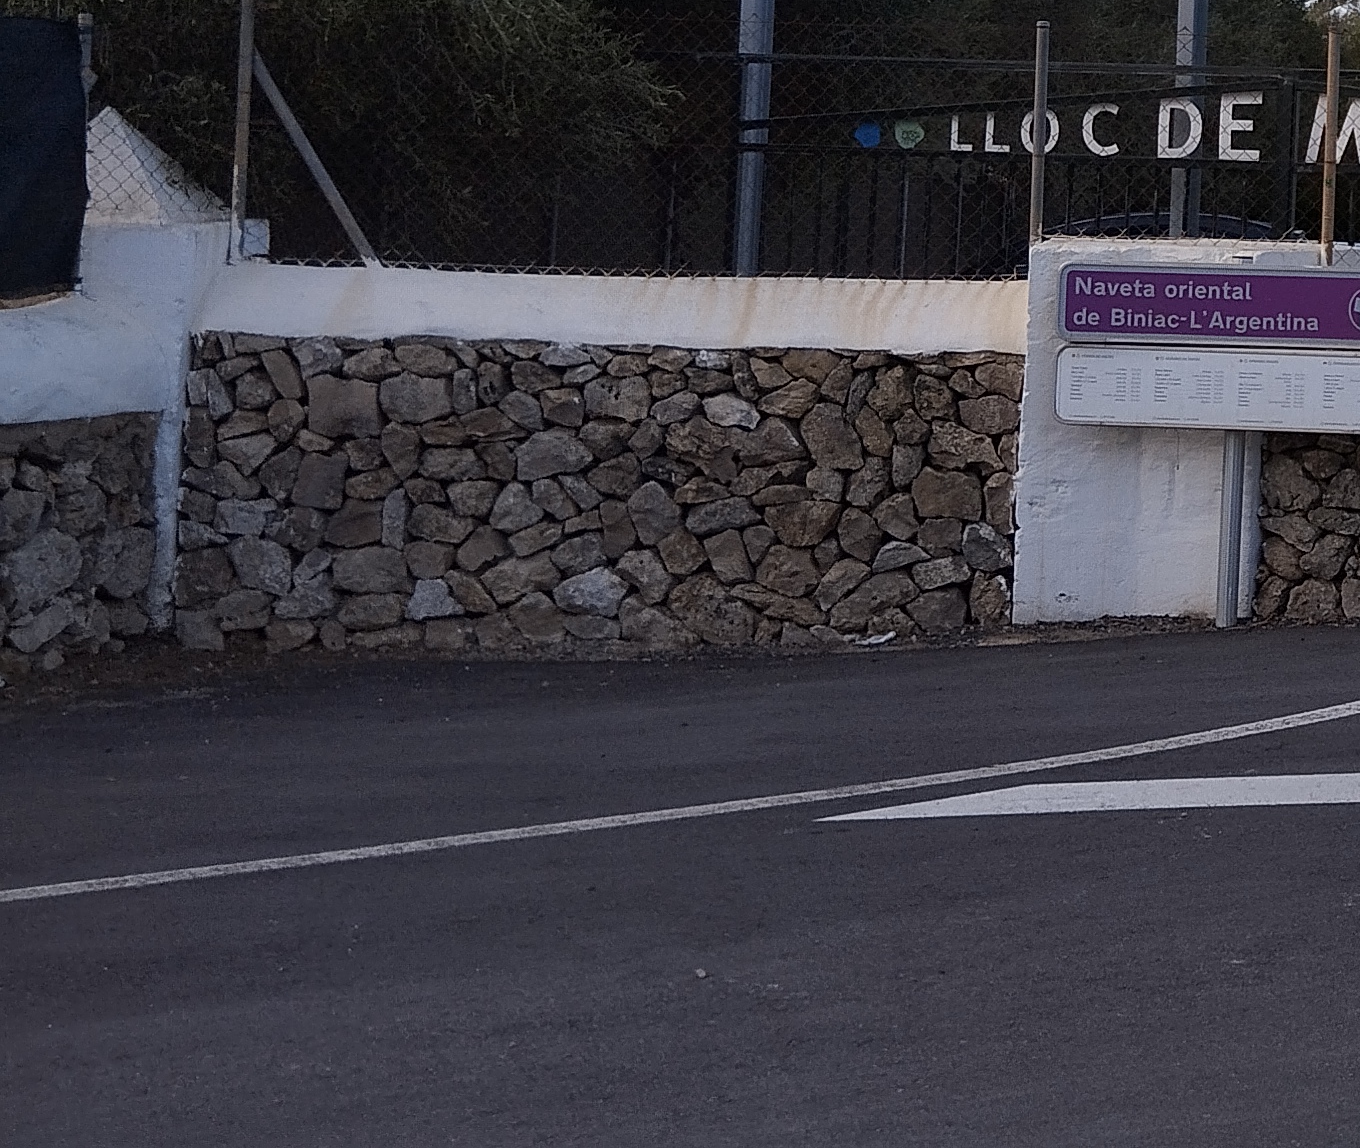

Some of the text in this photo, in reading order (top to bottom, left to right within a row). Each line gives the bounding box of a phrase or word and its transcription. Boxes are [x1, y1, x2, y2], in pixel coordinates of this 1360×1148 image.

[949, 102, 1120, 156] LLOC
[1156, 91, 1264, 162] DE
[1074, 276, 1253, 301] Naveta oriental
[1073, 307, 1319, 334] de Biniac-L'Argentina
